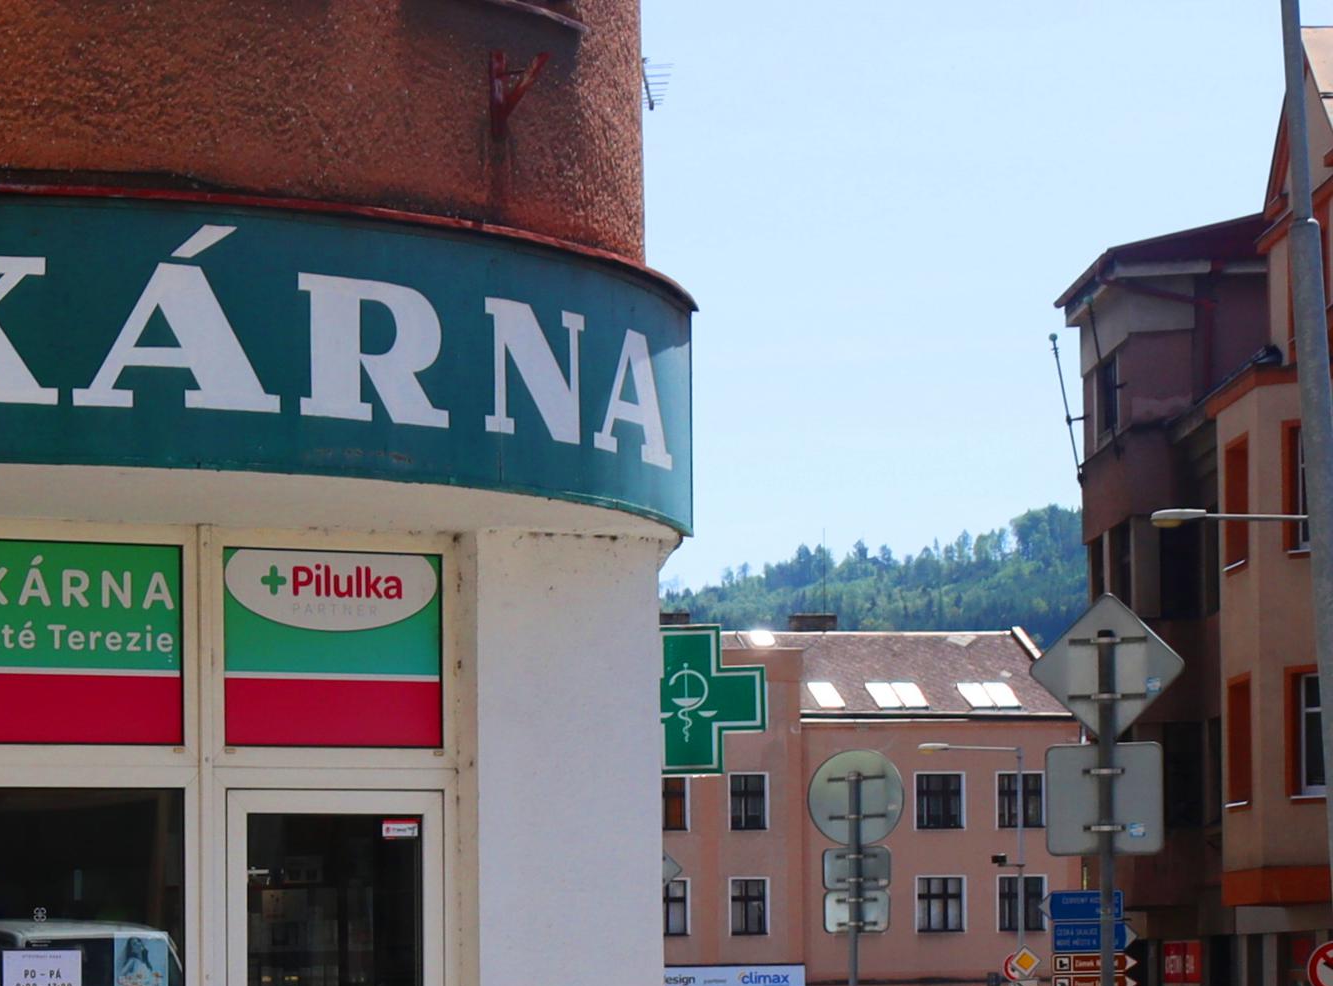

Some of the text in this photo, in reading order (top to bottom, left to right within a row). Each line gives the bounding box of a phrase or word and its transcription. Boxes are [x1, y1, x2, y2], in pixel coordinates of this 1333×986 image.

[291, 563, 404, 601] Pilulka
[291, 602, 379, 617] PARTNER
[47, 623, 173, 653] Terezie
[23, 968, 37, 979] PO
[49, 967, 62, 979] PÁ
[741, 972, 790, 985] climax
